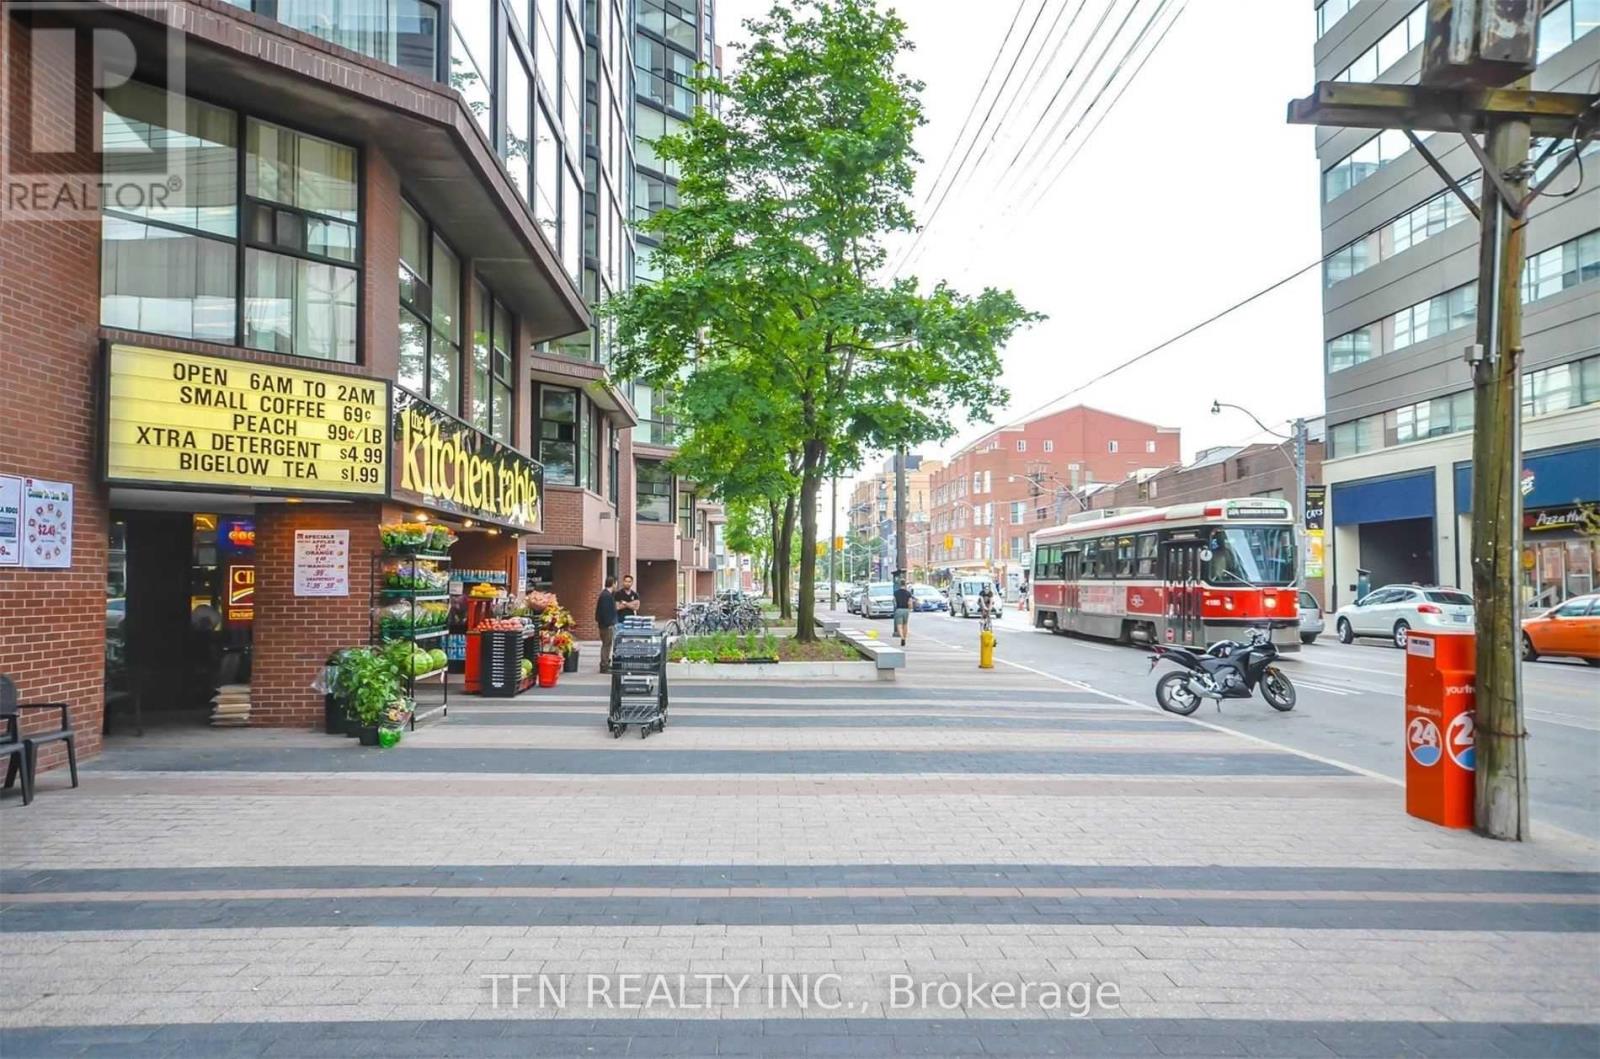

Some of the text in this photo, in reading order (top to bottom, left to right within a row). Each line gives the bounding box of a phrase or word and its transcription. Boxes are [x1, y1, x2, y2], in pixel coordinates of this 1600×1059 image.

[173, 362, 375, 405] OPEN 6AM TO 2AM
[179, 386, 372, 423] SMALL COFFEE 69¢
[136, 426, 383, 464] XTRA DETERGENT $4.99
[233, 414, 382, 445] PEACH 99¢/LB
[179, 452, 379, 483] BIGELOW TEA $1.99
[401, 405, 538, 524] kitchen table
[1536, 511, 1565, 526] Pizza
[1411, 719, 1437, 747] 24
[1454, 716, 1476, 746] 2
